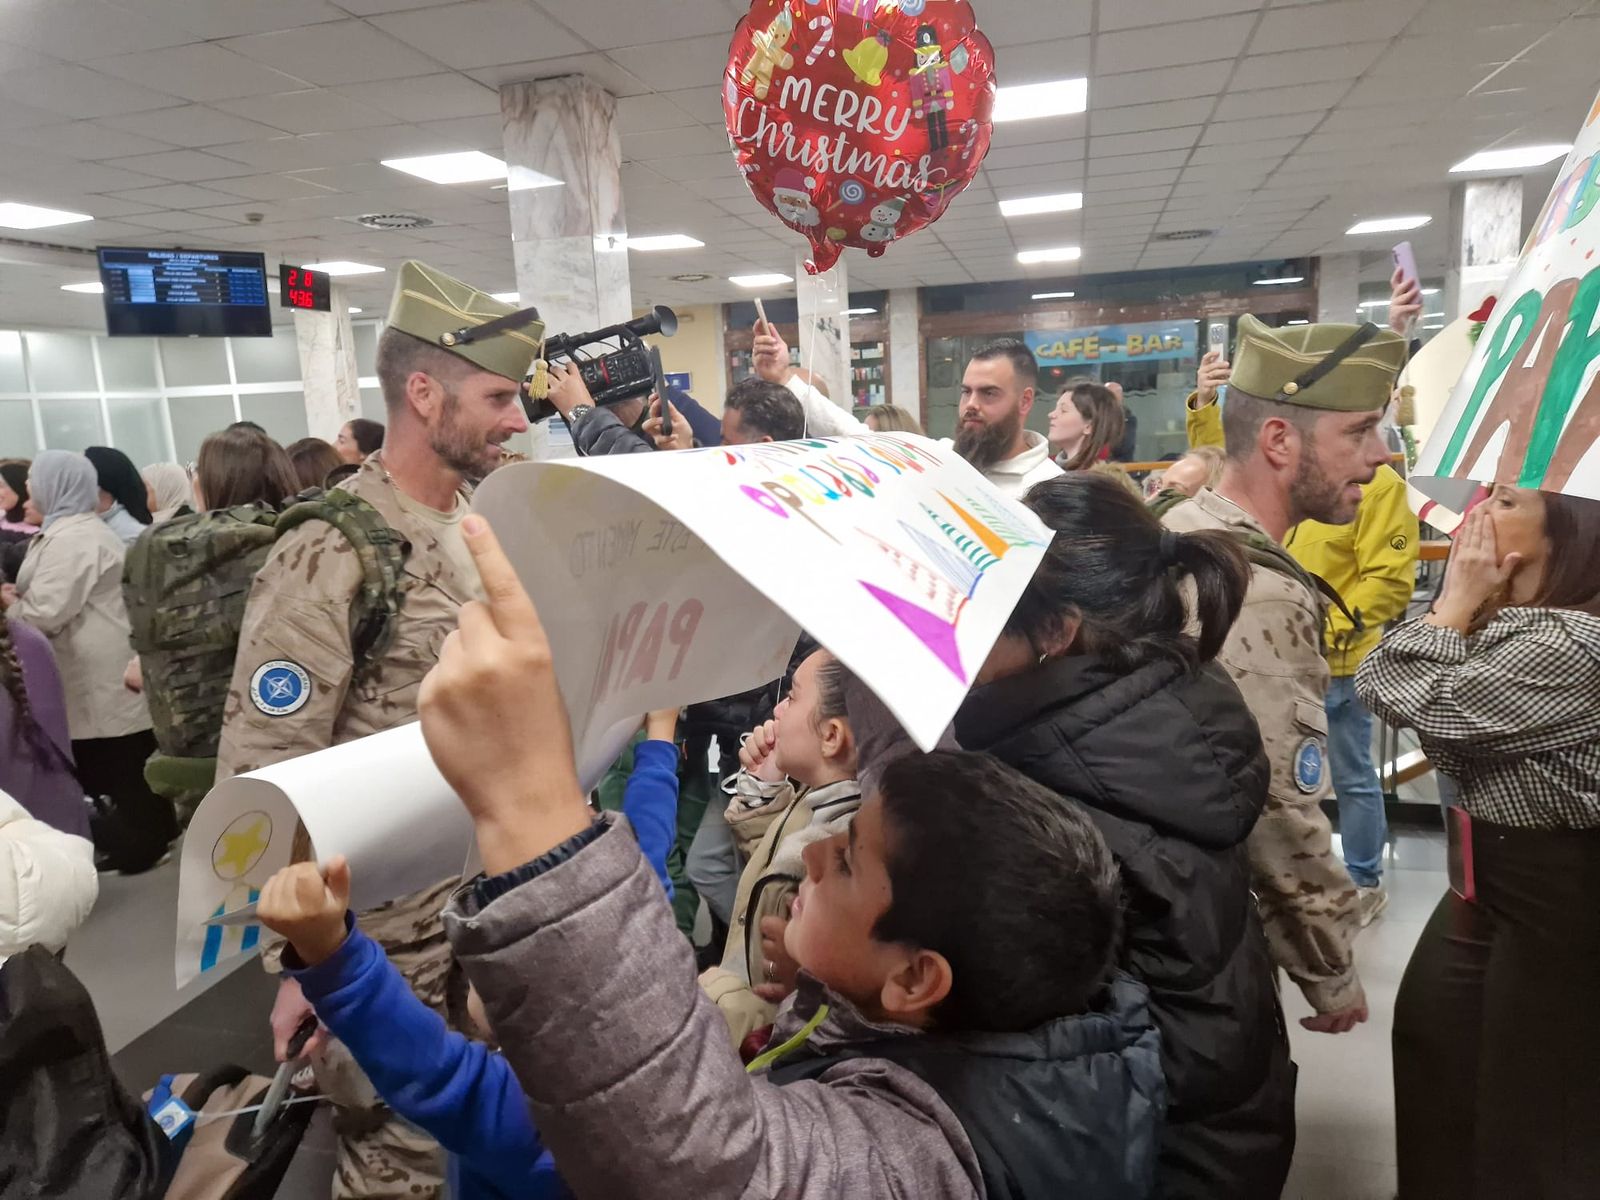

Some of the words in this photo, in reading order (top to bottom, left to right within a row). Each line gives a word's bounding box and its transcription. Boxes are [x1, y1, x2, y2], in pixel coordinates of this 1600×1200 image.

[779, 75, 912, 142] MERRY
[736, 97, 948, 193] Christmas
[1035, 331, 1099, 360] CAFÉ
[1126, 334, 1184, 357] BAR
